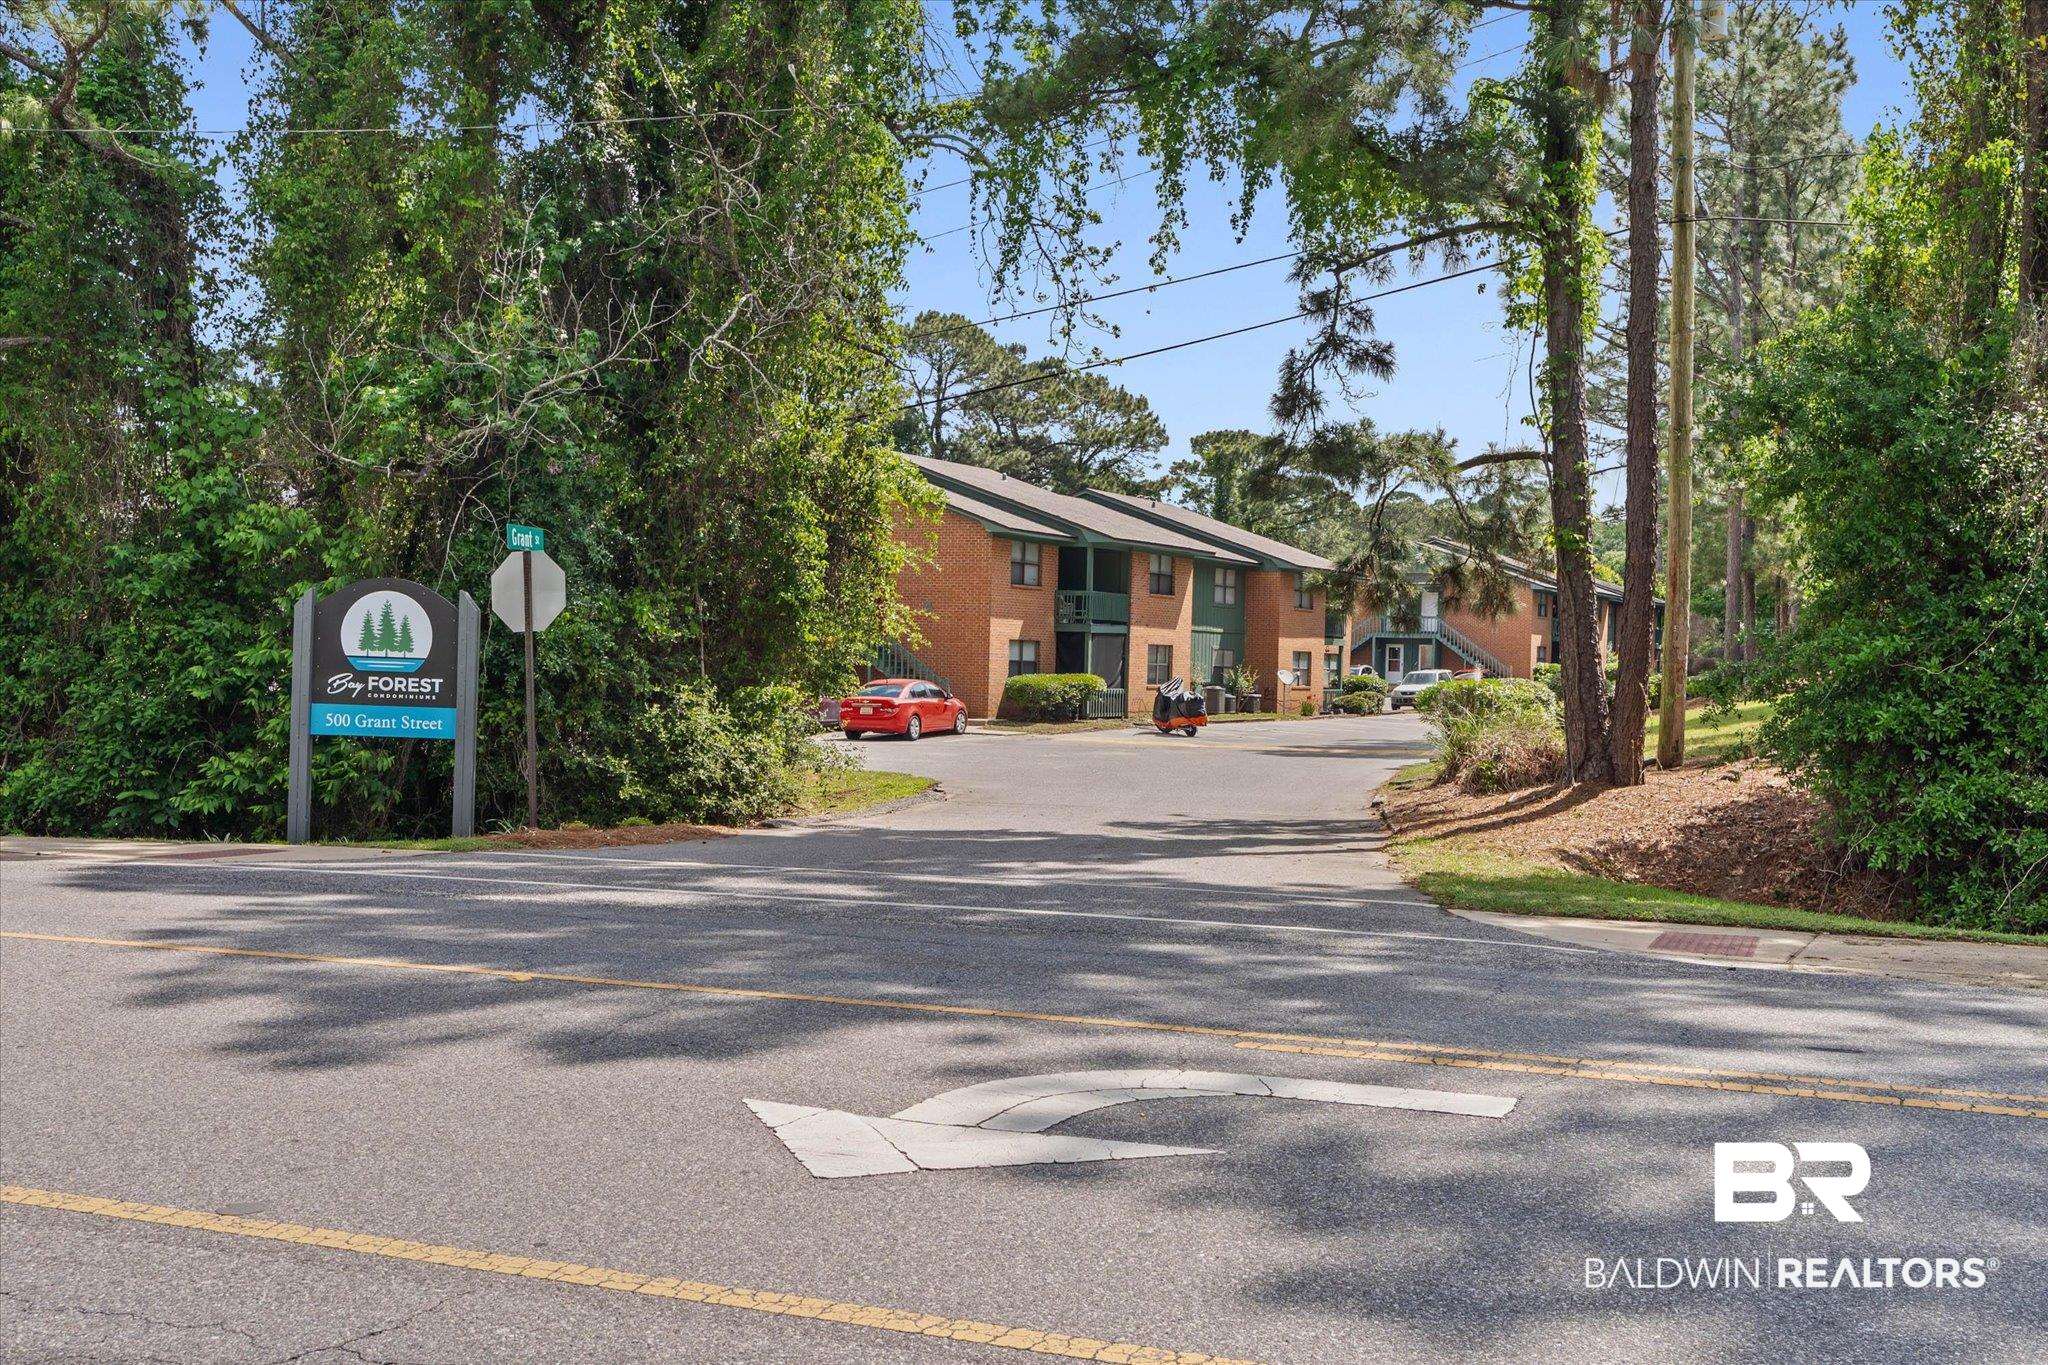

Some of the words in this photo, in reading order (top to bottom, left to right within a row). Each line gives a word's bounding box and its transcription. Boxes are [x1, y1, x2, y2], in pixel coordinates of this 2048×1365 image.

[511, 527, 533, 548] Grant
[326, 672, 366, 698] Bay
[368, 676, 444, 693] FOREST
[325, 713, 351, 728] 500
[355, 714, 397, 729] Grant
[401, 716, 443, 730] Street
